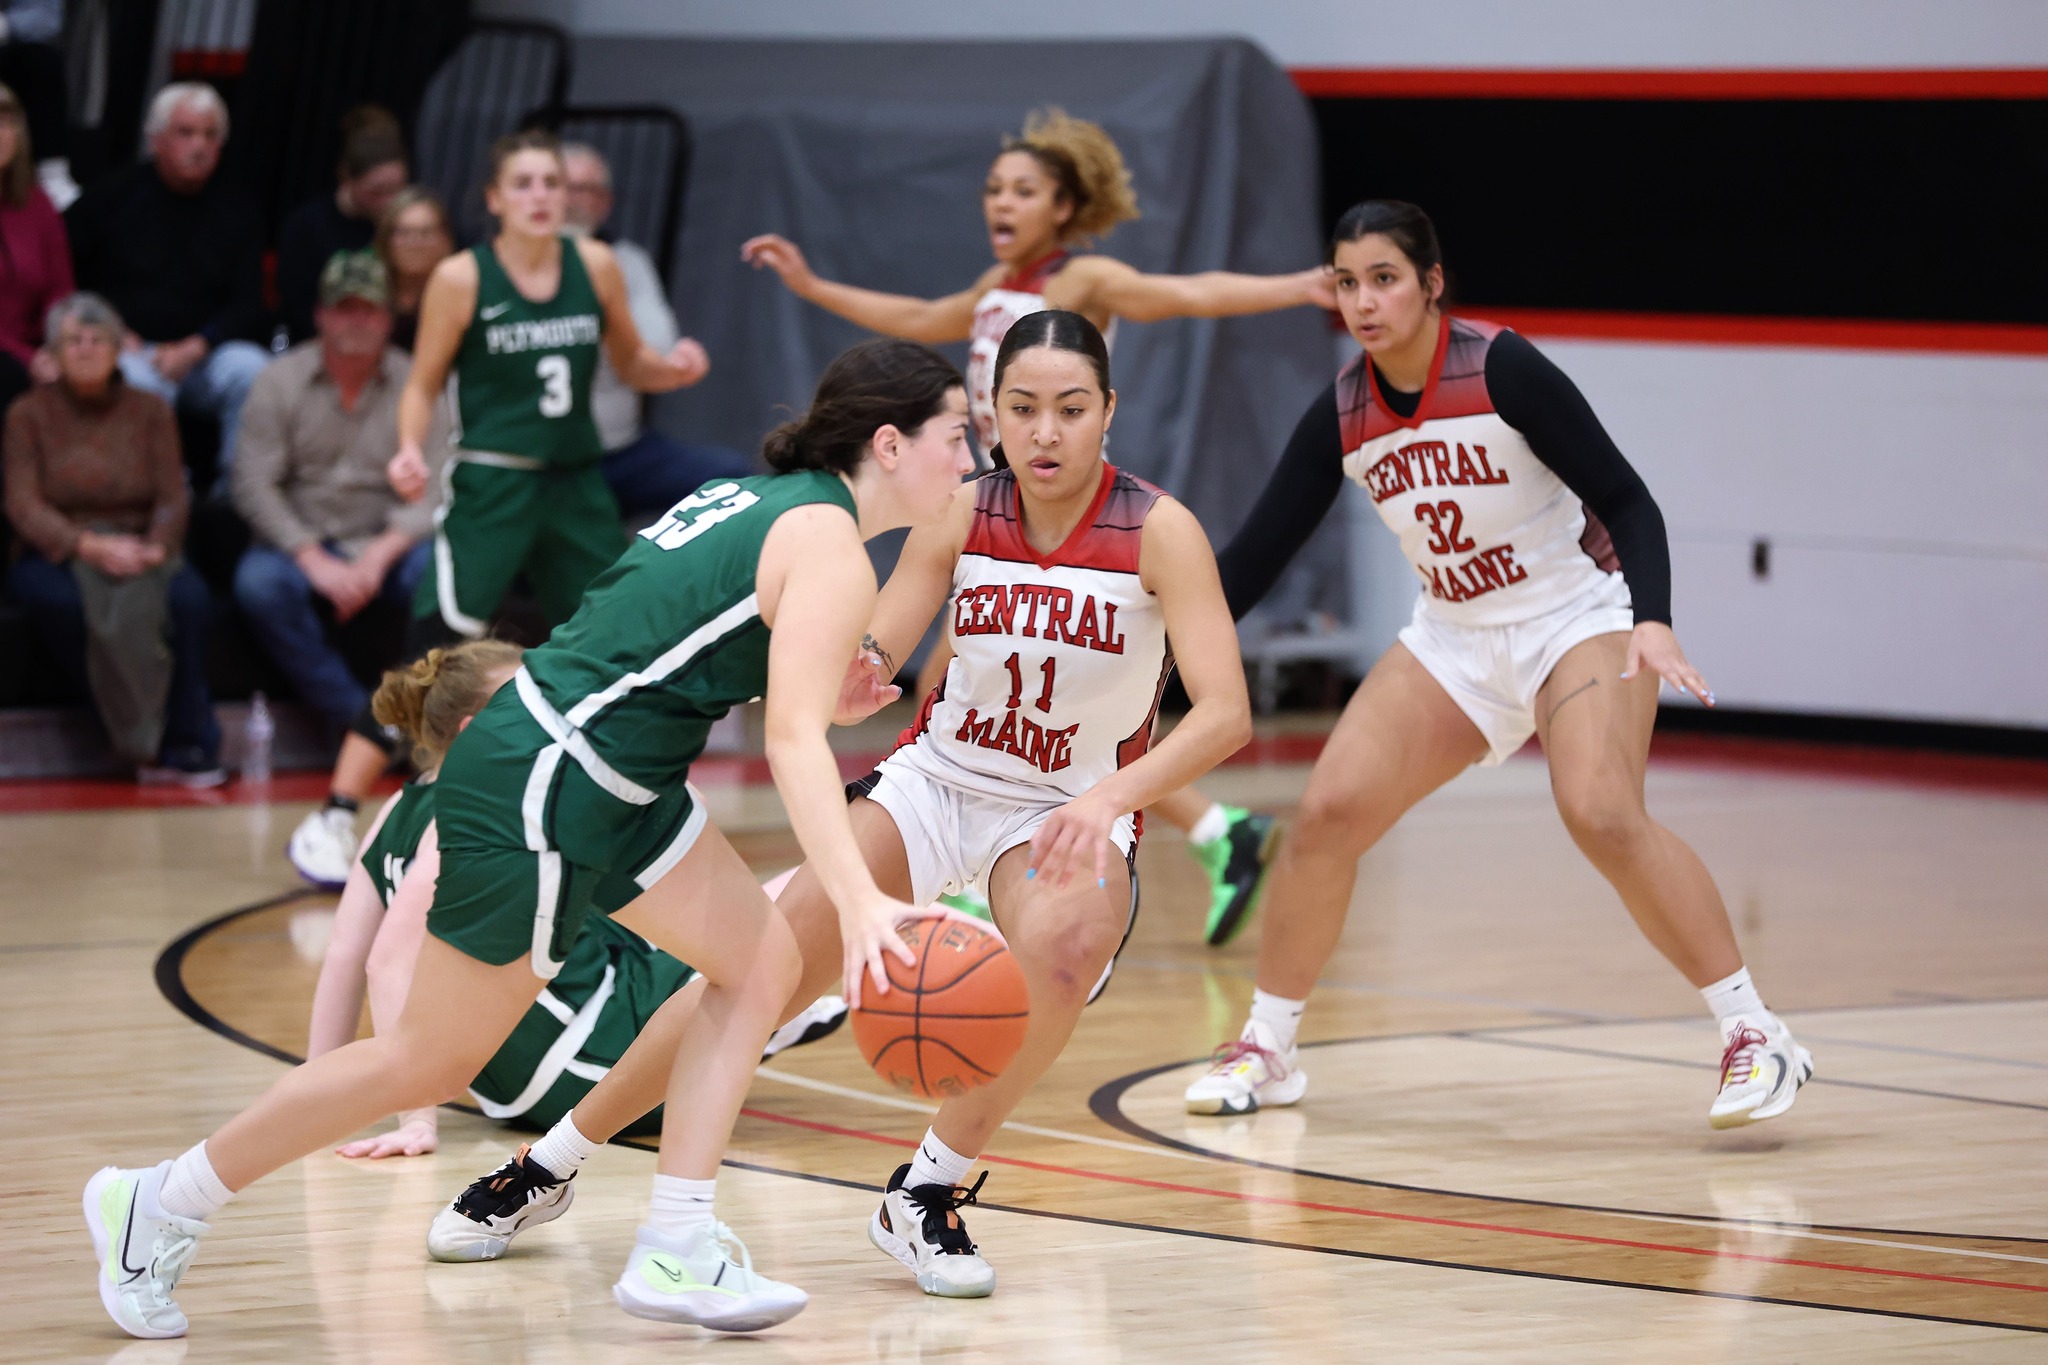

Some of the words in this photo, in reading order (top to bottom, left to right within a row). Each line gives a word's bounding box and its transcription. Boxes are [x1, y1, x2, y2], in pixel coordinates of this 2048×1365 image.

[535, 354, 573, 418] 3
[1363, 440, 1510, 504] CENTRAL
[636, 481, 762, 551] 23
[1414, 500, 1476, 555] 32
[1418, 543, 1528, 603] MAINE
[954, 583, 1125, 655] CENTRAL
[1004, 652, 1056, 713] 11
[955, 708, 1080, 773] MAINE
